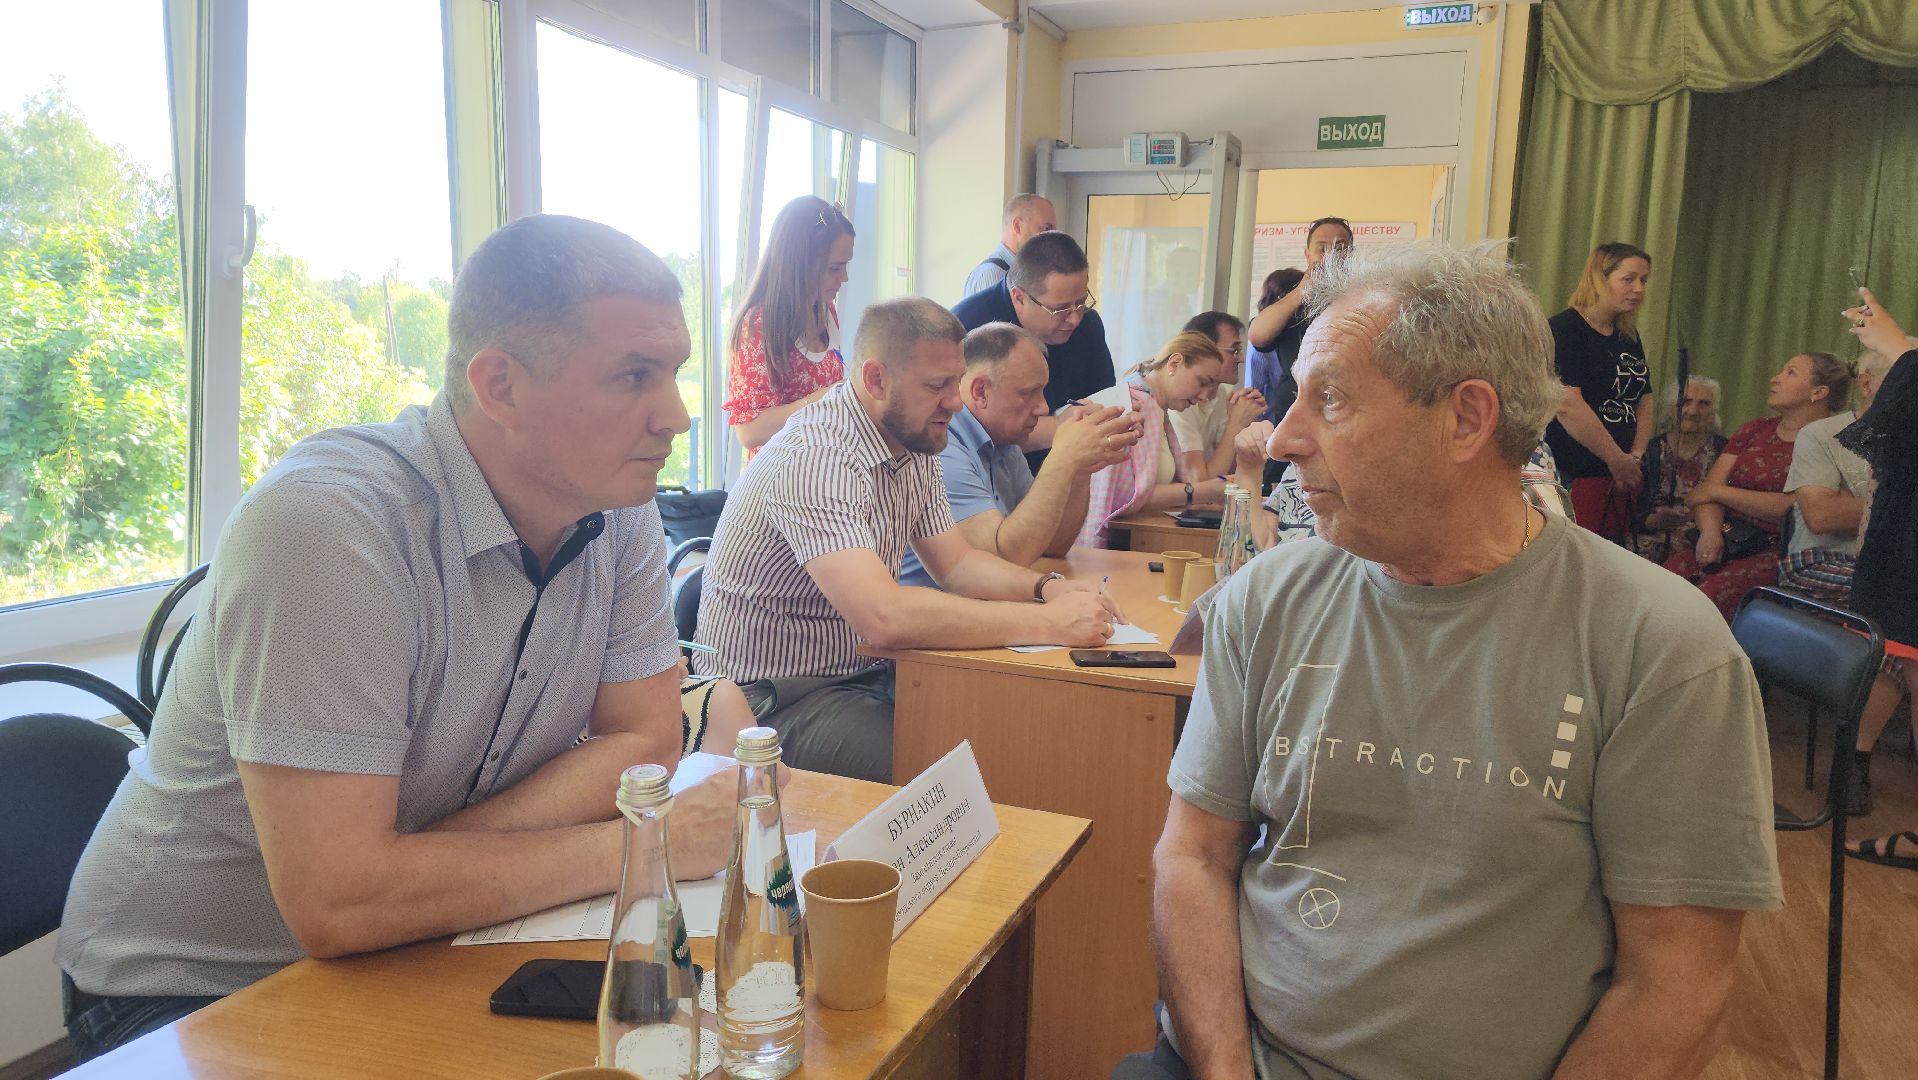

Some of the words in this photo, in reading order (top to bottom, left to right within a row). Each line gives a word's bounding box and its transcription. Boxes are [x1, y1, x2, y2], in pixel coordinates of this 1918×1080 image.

[1410, 6, 1471, 24] ВЫХОД
[1320, 122, 1382, 142] ВЫХОД
[1255, 227, 1284, 237] РИЗМ
[1290, 226, 1309, 236] УГР
[1352, 225, 1401, 236] ЩЕСТВУ
[887, 782, 947, 842] БУРНАКИН
[907, 798, 971, 865] Александрович
